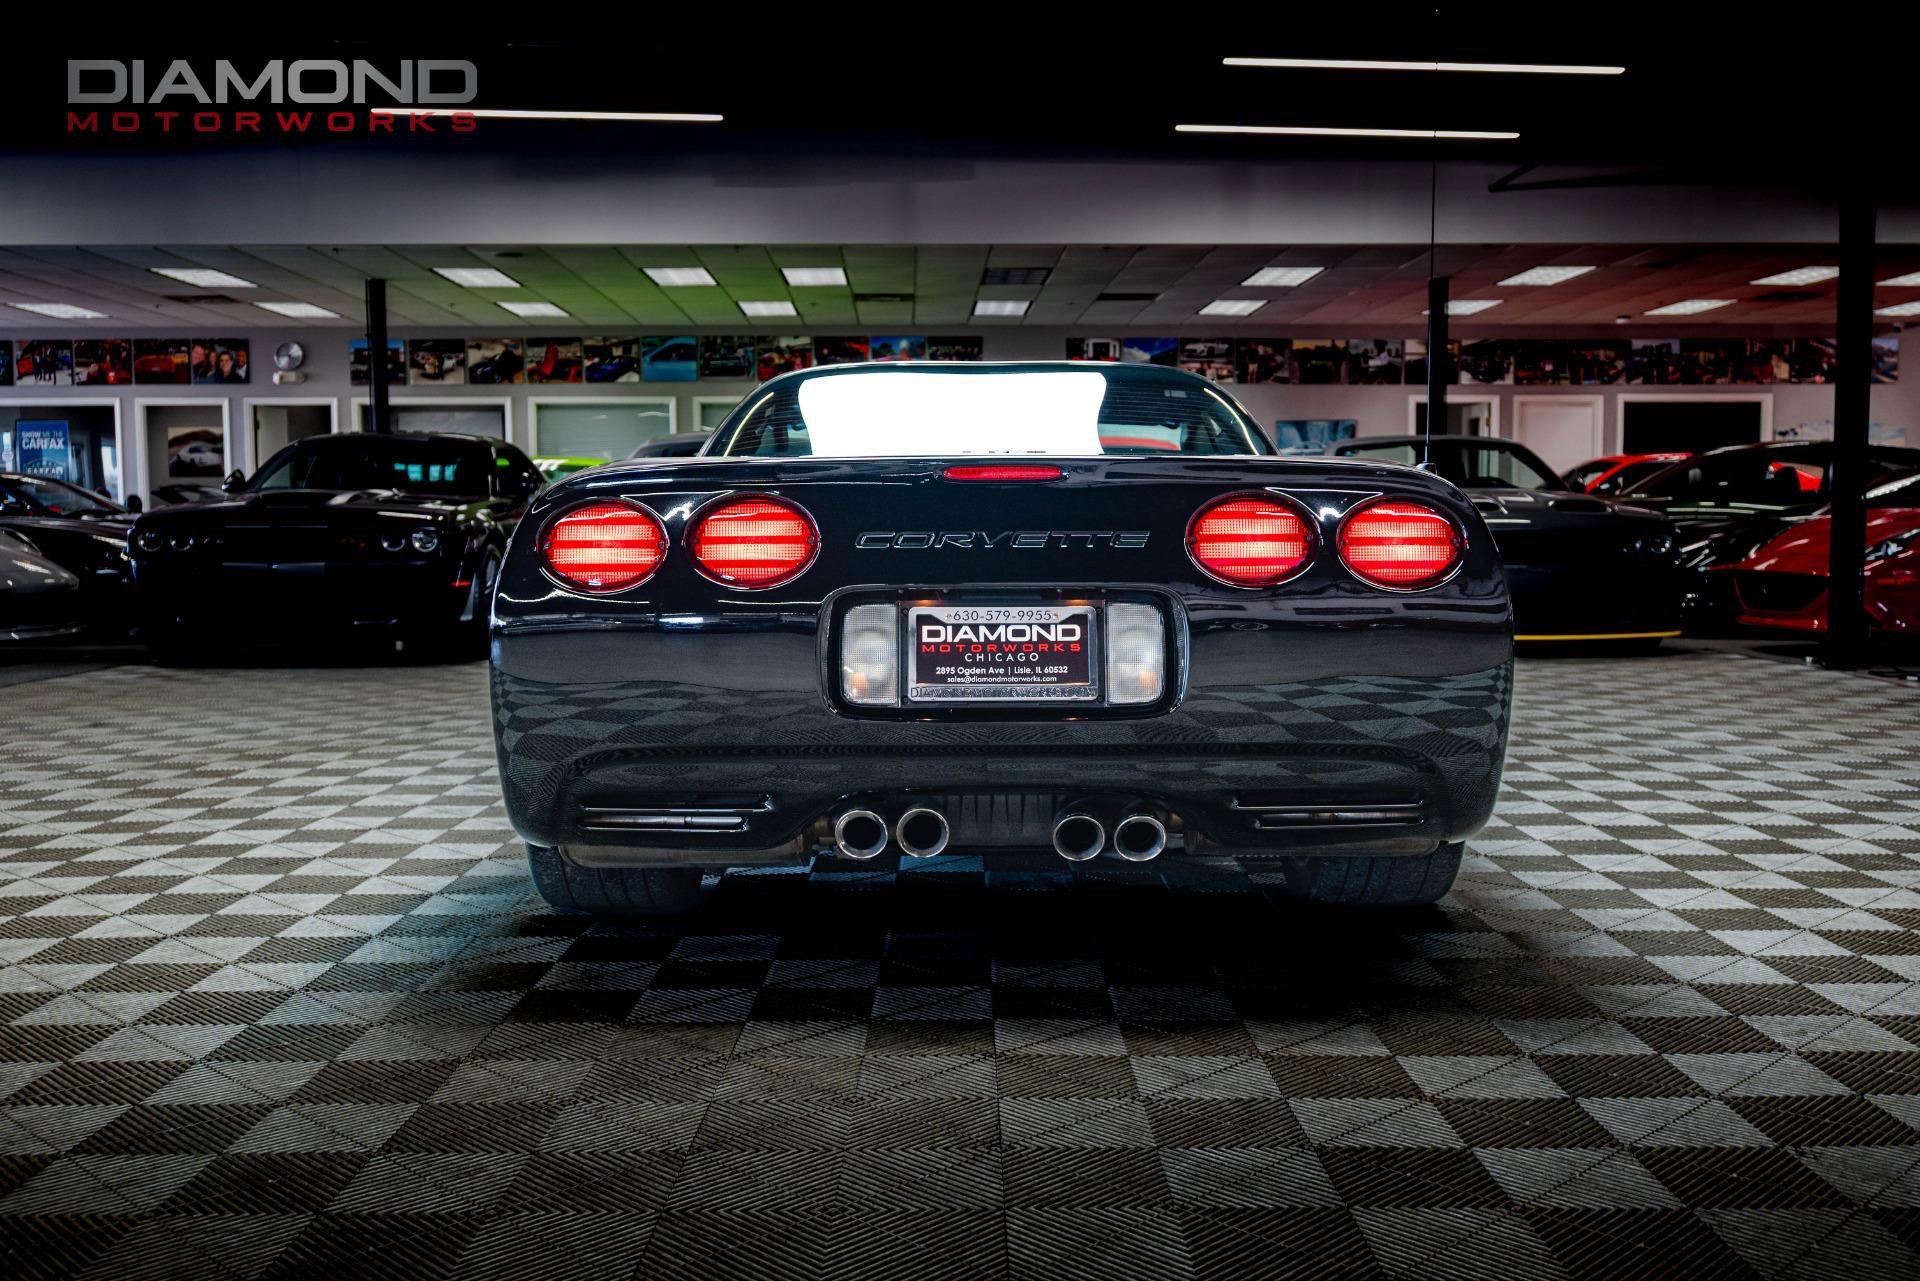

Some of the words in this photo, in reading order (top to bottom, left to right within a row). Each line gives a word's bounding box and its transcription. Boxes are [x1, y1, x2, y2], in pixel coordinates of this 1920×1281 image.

[22, 437, 64, 450] CARFAX
[855, 530, 1151, 549] CORVETTE
[953, 610, 1052, 621] 630-579-9955
[921, 624, 1081, 643] DIAMOND
[921, 644, 1081, 653] MOTORWORKS
[964, 652, 1039, 662] CHICAGO
[935, 666, 956, 675] 2895
[957, 666, 987, 676] Ogden
[988, 666, 1005, 675] Ave
[1014, 666, 1034, 675] Lisle,
[1035, 666, 1042, 674] IL
[1043, 665, 1069, 674] 60532
[947, 675, 1057, 684] sales@diamondmotorworks.com
